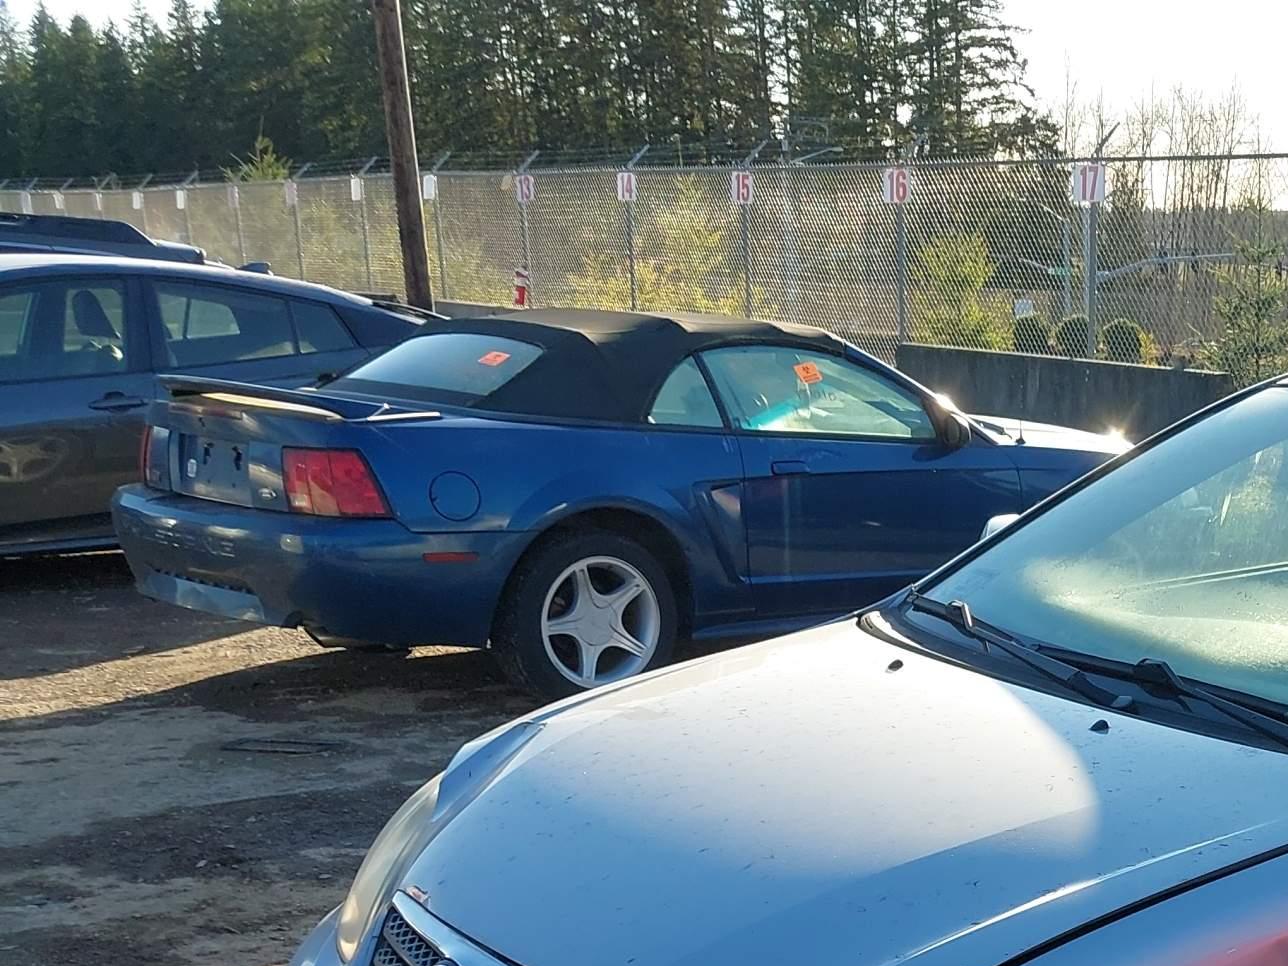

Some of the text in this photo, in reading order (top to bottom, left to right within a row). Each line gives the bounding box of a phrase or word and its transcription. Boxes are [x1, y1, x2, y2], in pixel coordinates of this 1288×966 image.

[519, 176, 532, 200] 13
[620, 175, 633, 199] 14
[735, 174, 751, 201] 15
[888, 169, 907, 202] 16
[1079, 165, 1099, 200] 17
